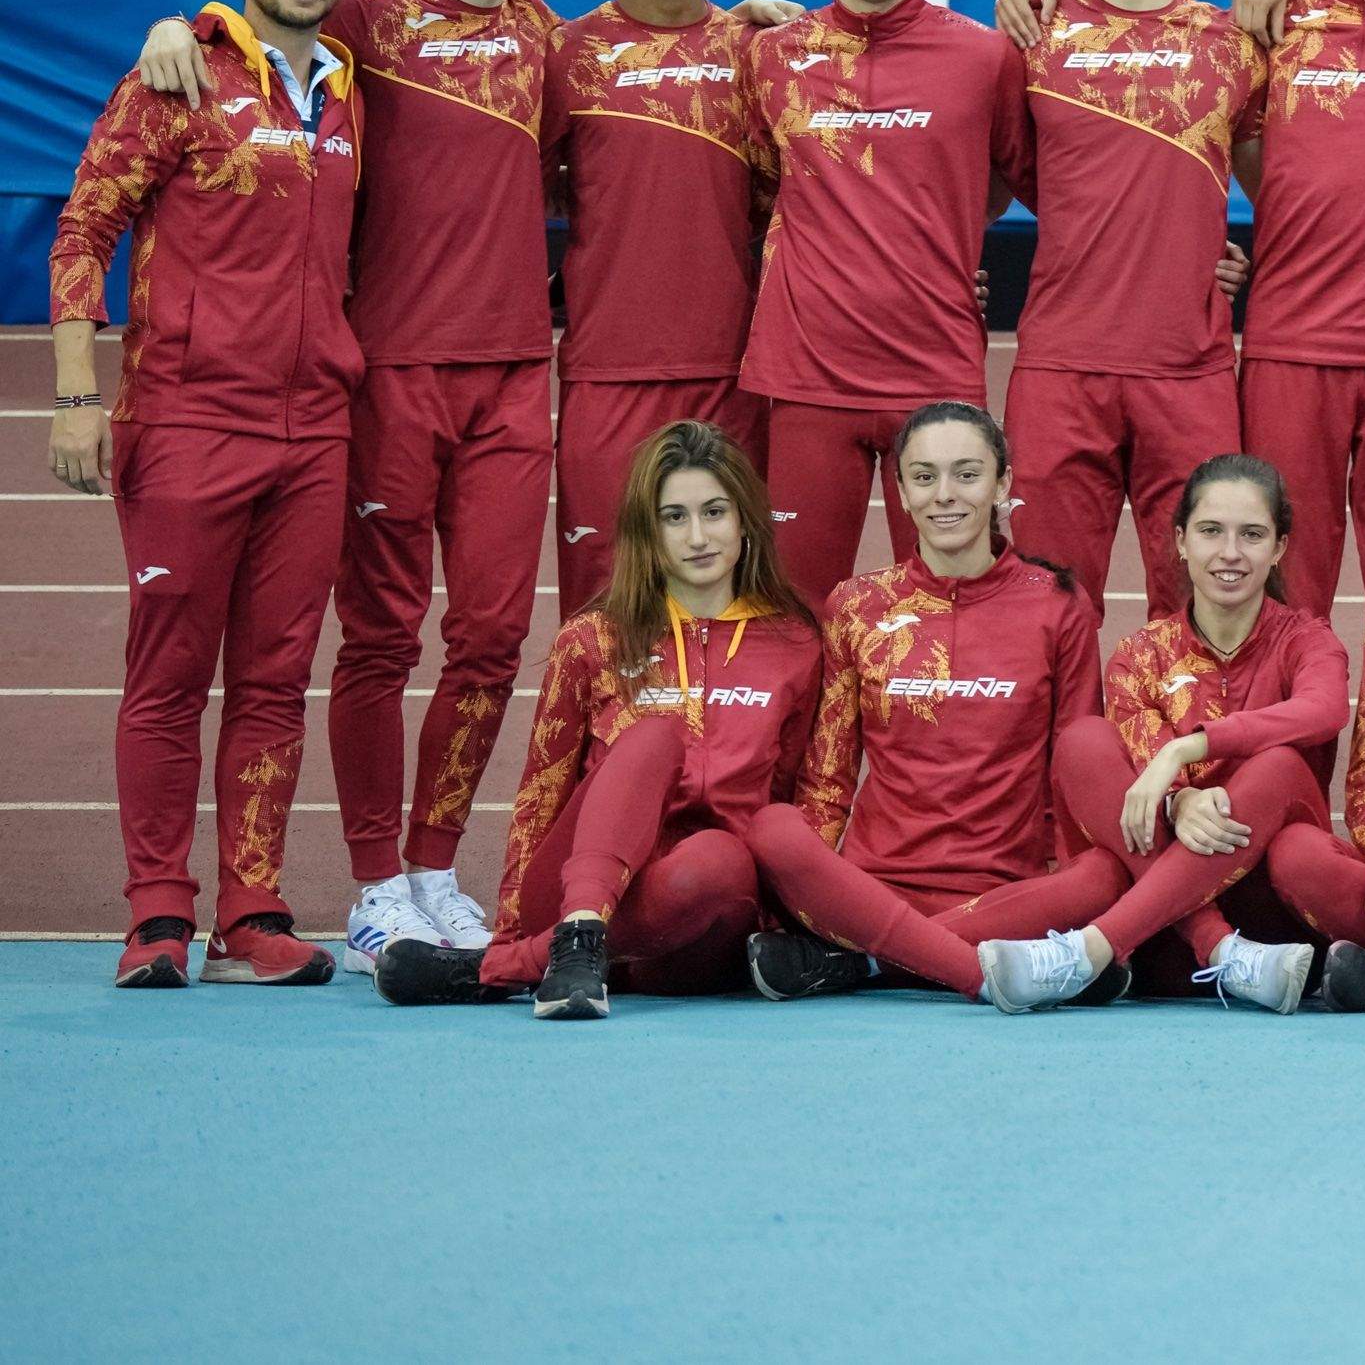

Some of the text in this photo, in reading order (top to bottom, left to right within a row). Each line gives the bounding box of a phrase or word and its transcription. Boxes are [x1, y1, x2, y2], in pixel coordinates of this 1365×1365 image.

[418, 36, 521, 59] ESPAÑA
[1063, 50, 1194, 69] ESPAÑA
[615, 64, 735, 88] ESPAÑA
[808, 109, 932, 129] ESPAÑA
[884, 676, 1017, 698] ESPAÑA
